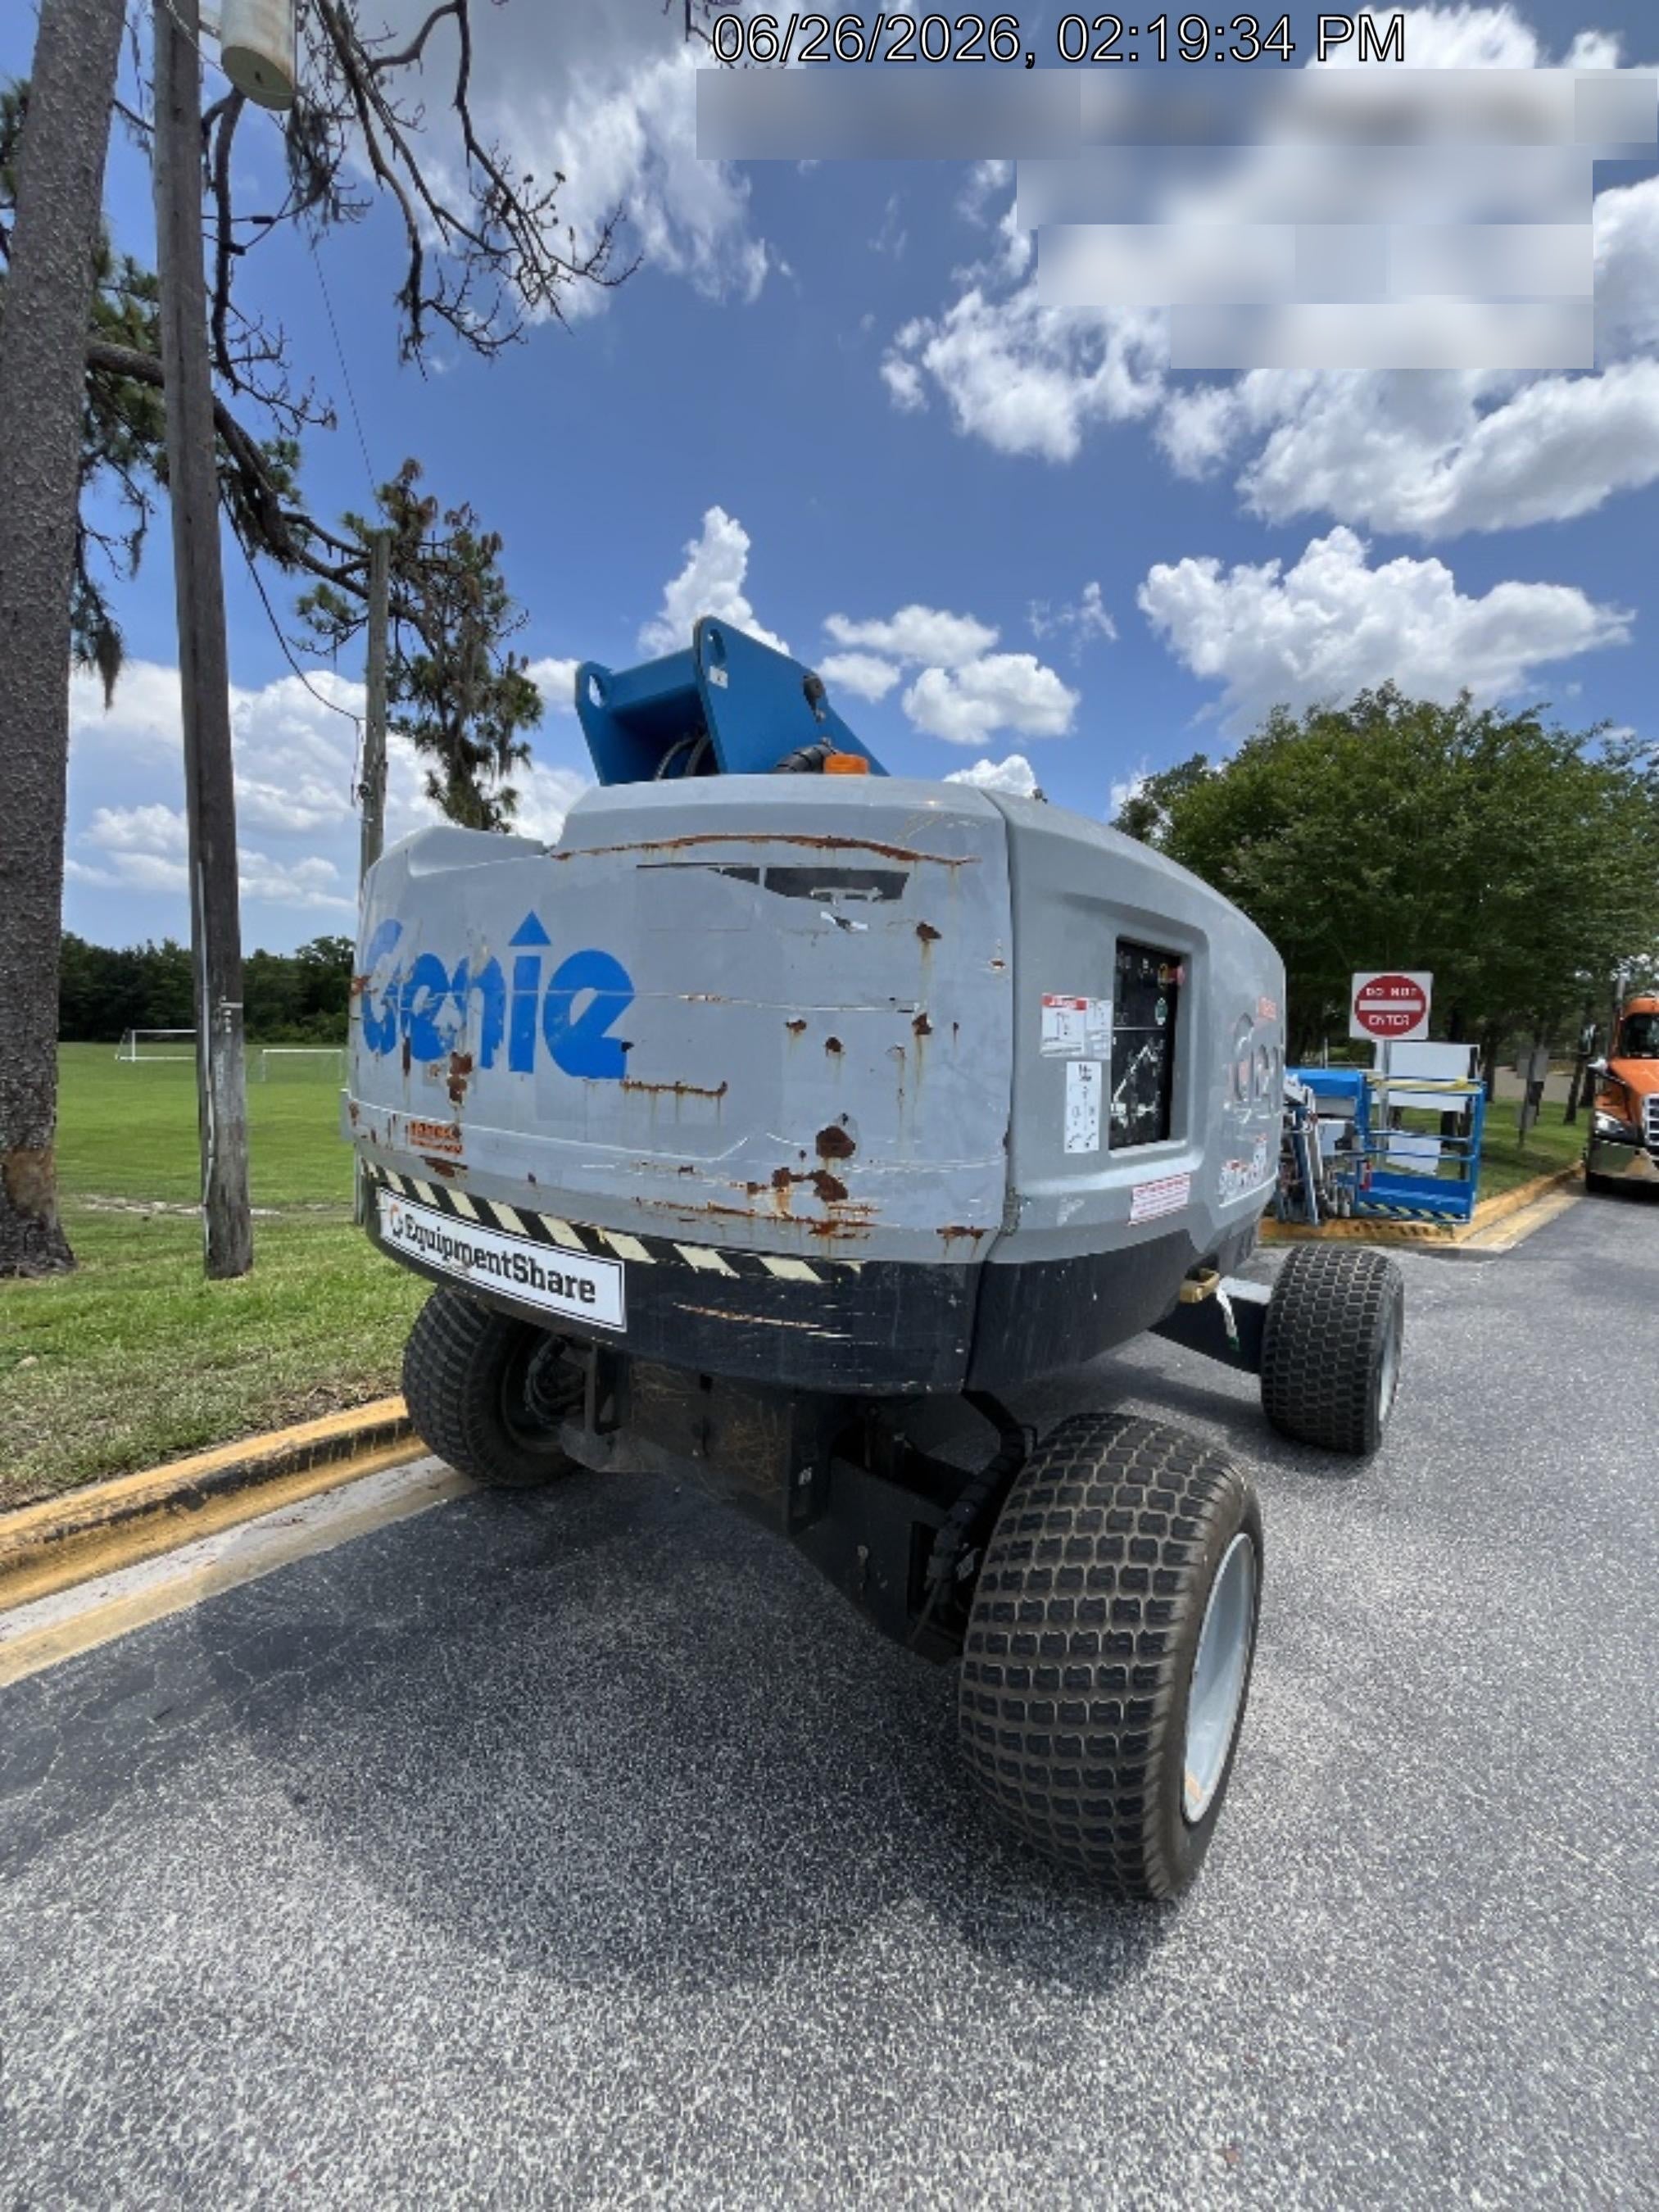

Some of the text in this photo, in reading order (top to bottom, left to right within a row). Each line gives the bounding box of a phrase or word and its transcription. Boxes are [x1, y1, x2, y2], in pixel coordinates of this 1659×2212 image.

[360, 911, 636, 1081] Genie
[1366, 987, 1416, 996] DO NOT
[1369, 1014, 1409, 1026] ENTER
[404, 1213, 596, 1304] EquipmentShare
